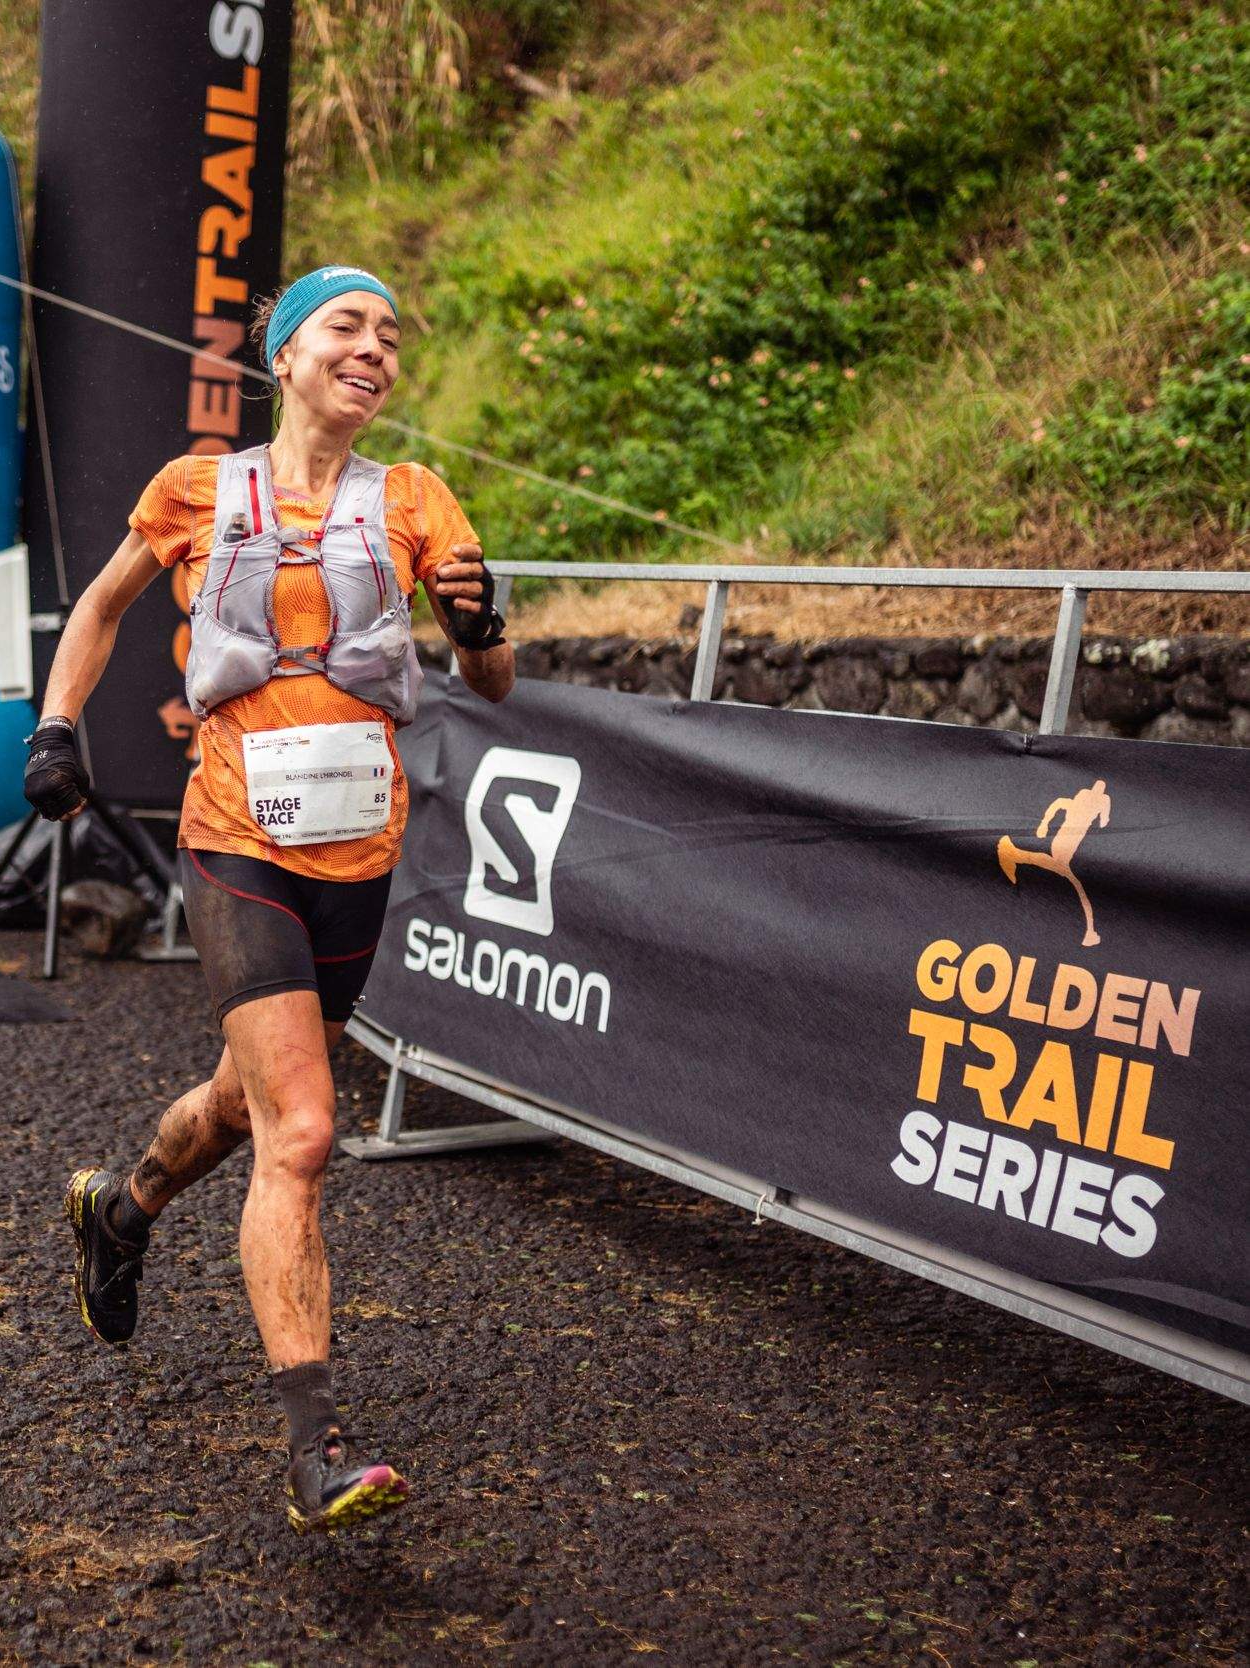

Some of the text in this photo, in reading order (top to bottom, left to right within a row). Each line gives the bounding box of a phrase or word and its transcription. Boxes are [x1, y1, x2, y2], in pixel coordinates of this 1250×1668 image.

[209, 0, 265, 66] S
[194, 64, 261, 316] TRAIL
[255, 797, 301, 812] STAGE
[257, 812, 295, 826] RACE
[374, 793, 386, 804] 85
[916, 939, 1201, 1057] GOLDEN
[908, 1008, 1175, 1170] TRAIL
[890, 1110, 1166, 1258] SERIES
